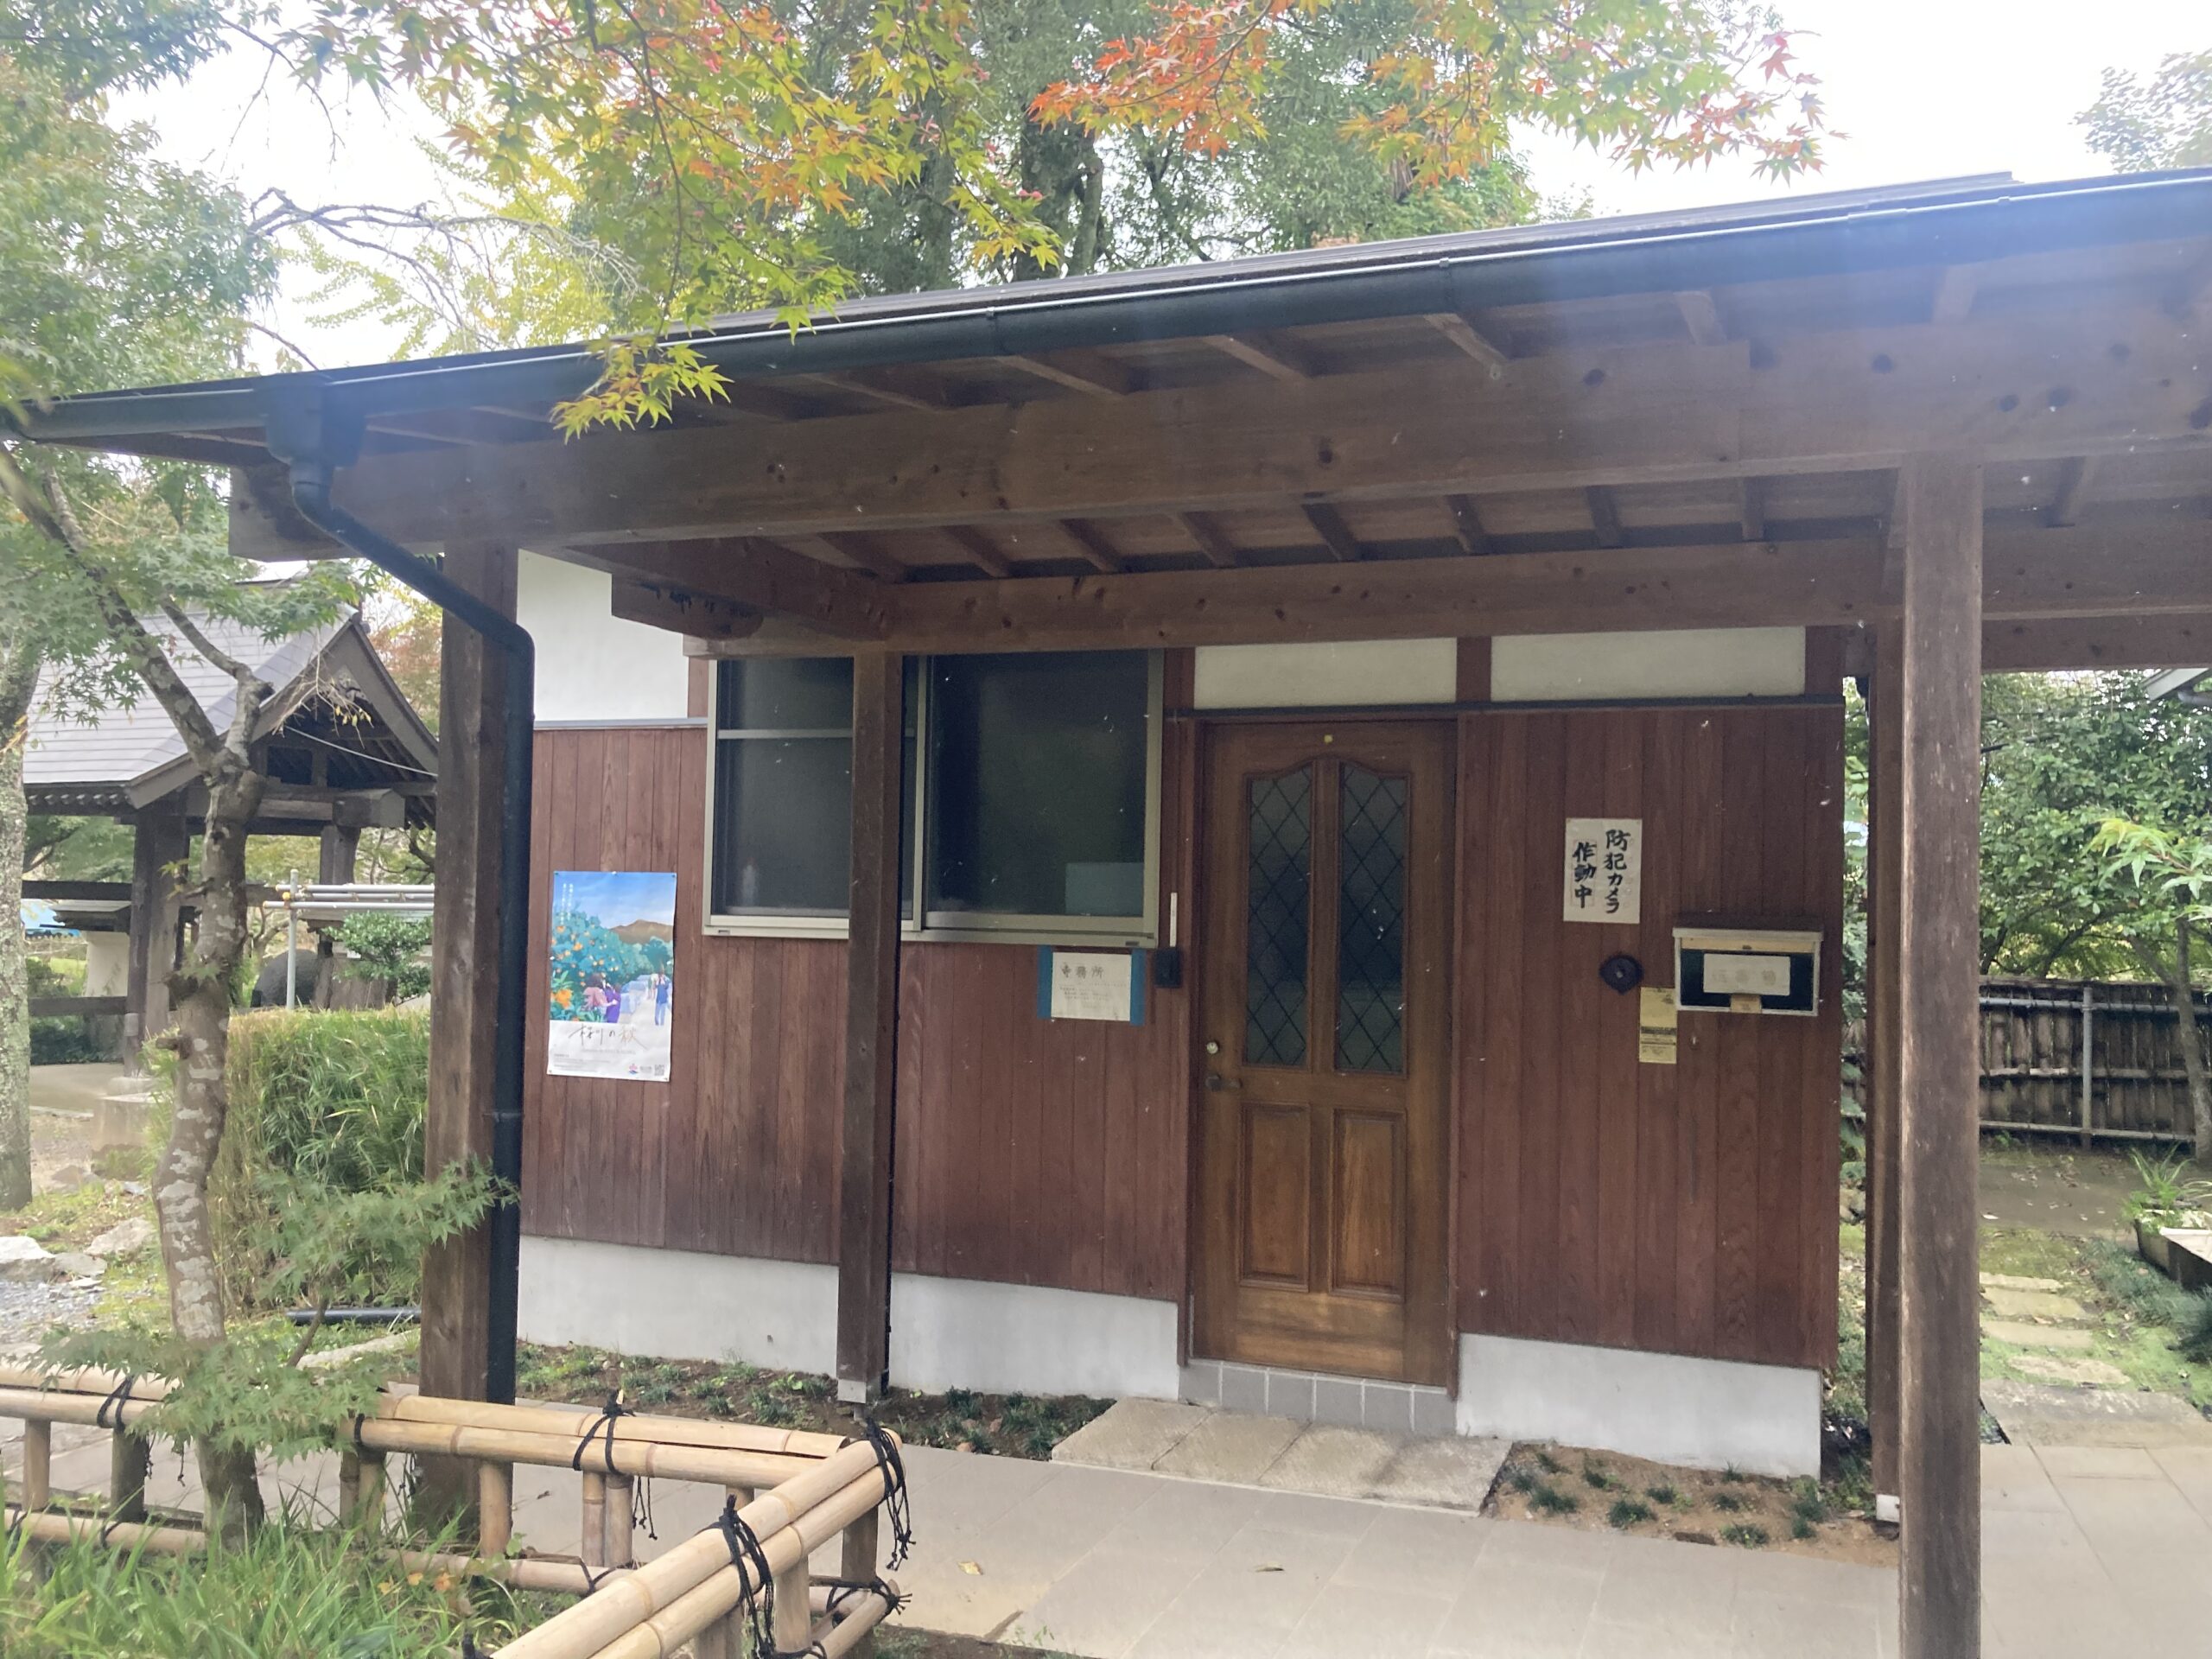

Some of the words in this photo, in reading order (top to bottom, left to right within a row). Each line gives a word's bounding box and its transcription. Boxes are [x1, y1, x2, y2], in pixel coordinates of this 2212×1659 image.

[1573, 842, 1597, 908] 作動中
[1604, 829, 1631, 913] 防犯カメラ
